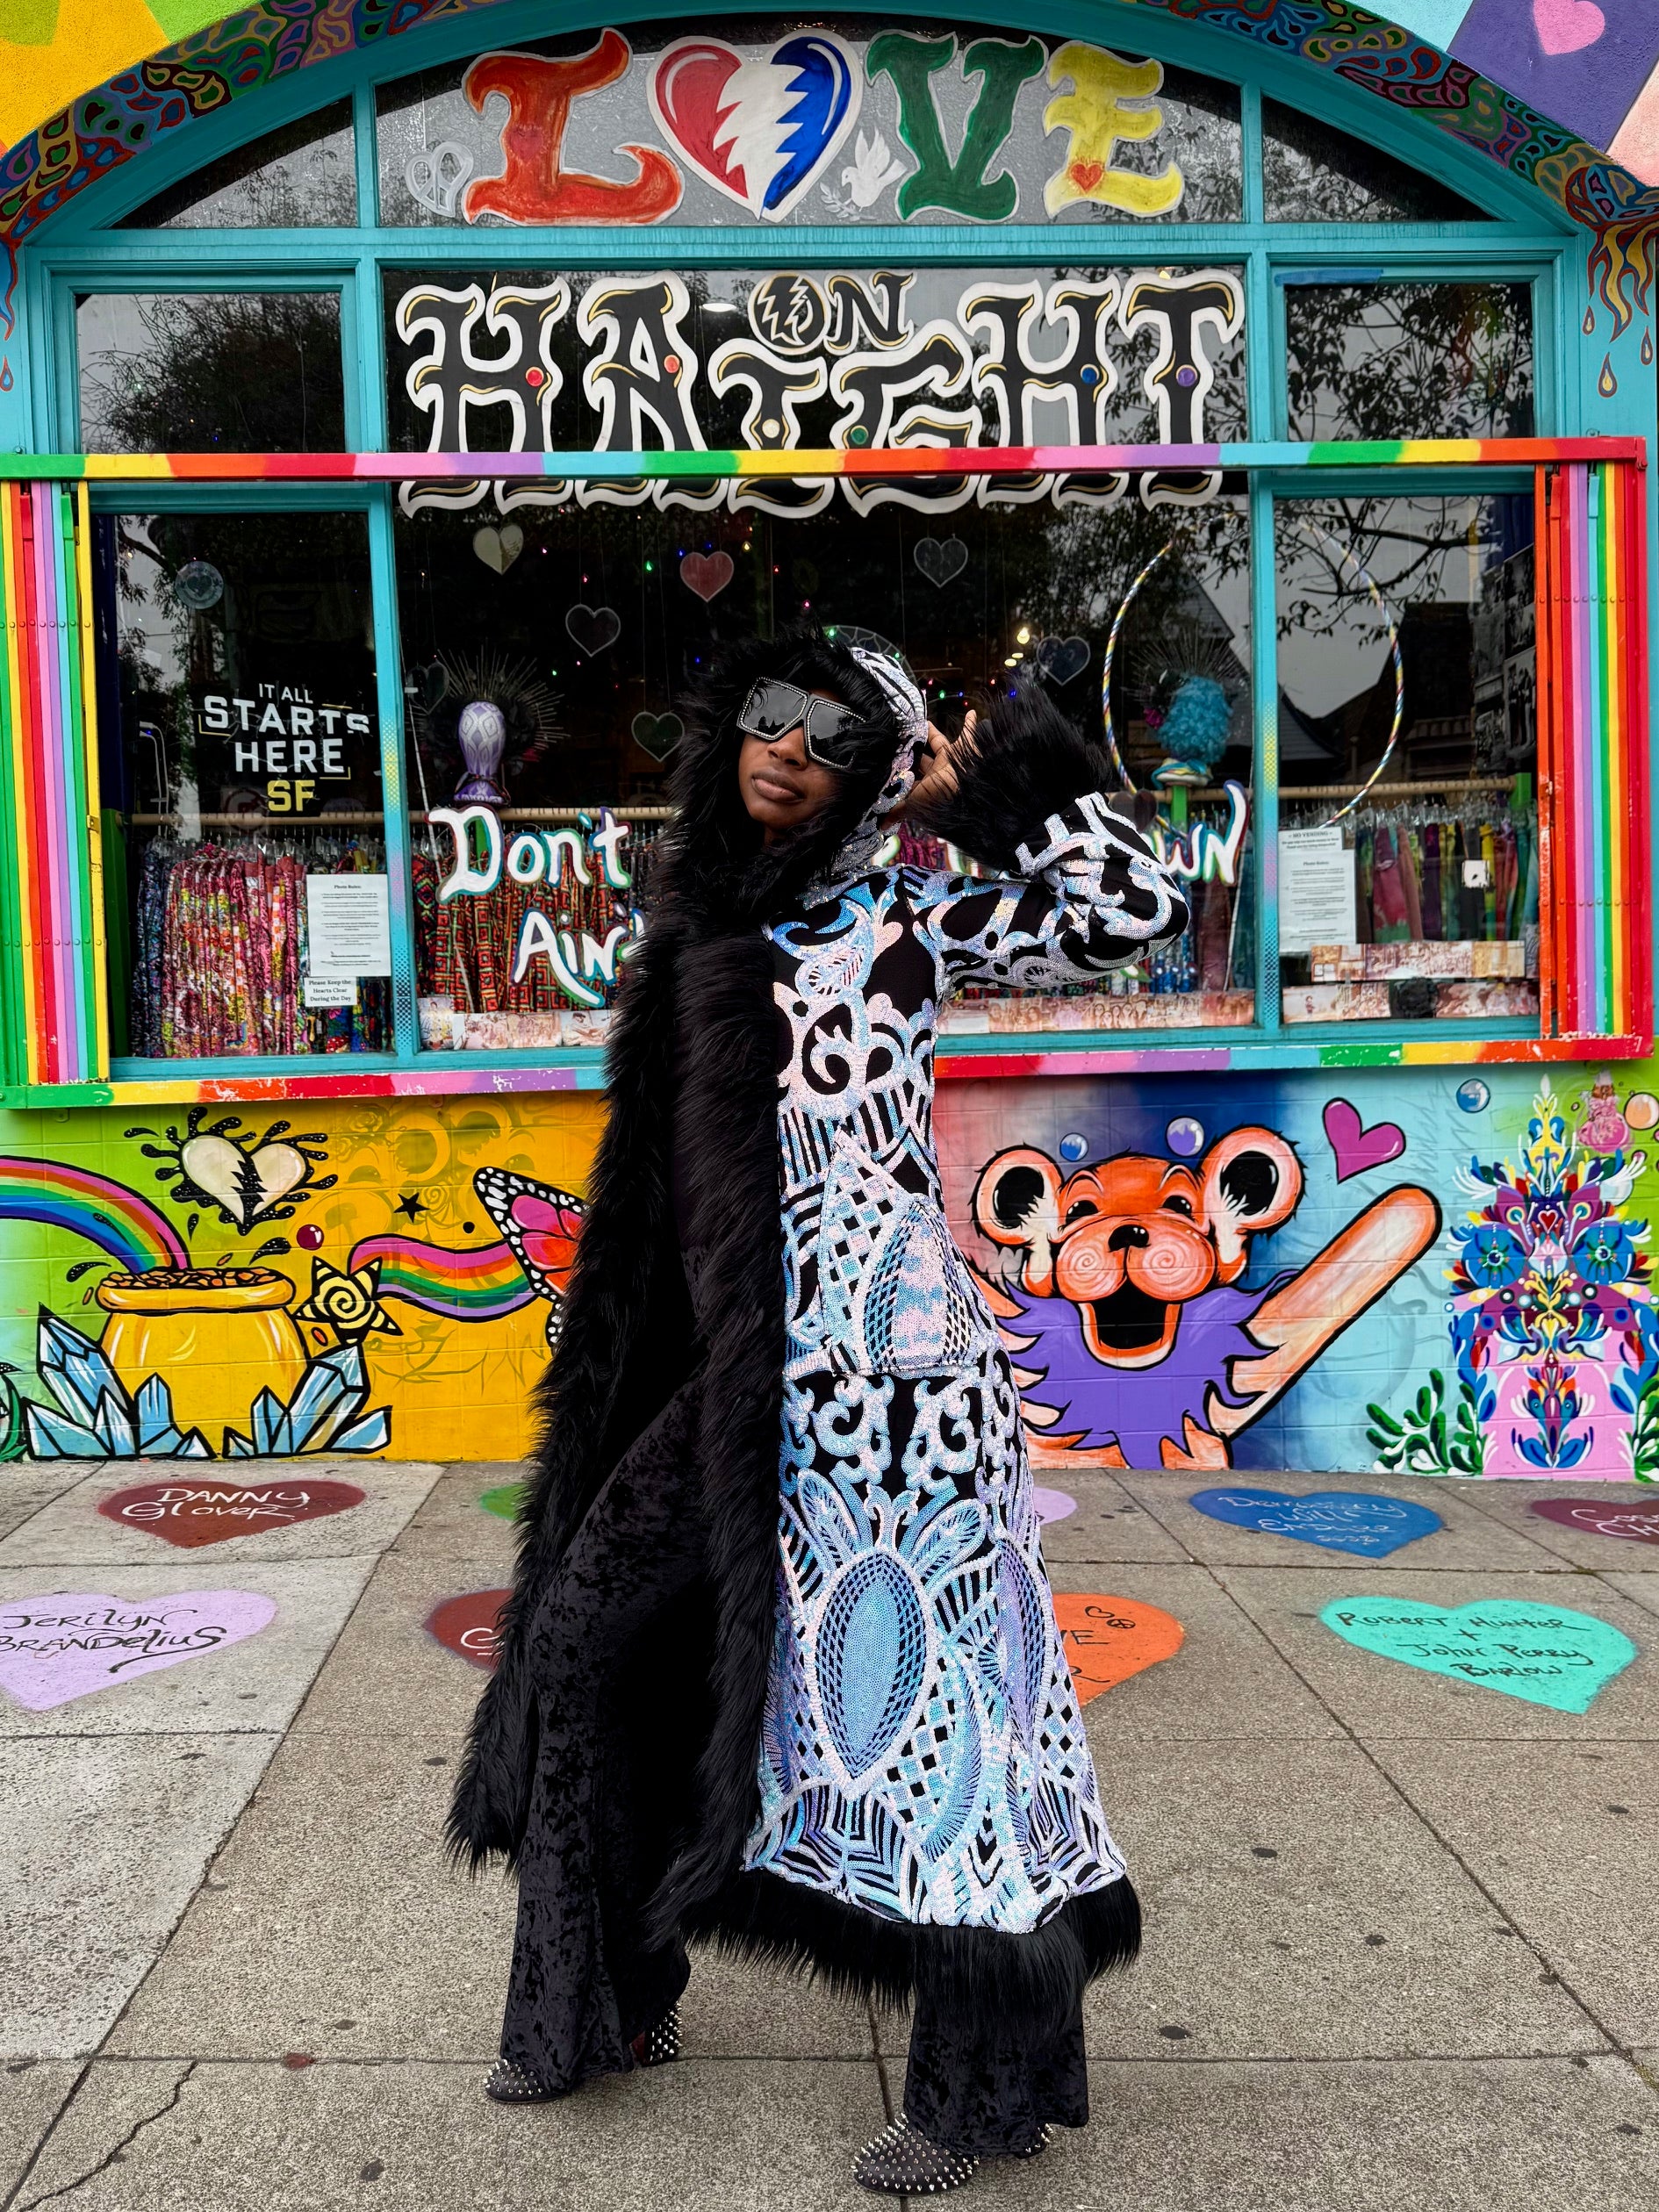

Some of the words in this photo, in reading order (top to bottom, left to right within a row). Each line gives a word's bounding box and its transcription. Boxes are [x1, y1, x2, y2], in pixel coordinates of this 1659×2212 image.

[748, 268, 917, 356] ON
[396, 269, 1246, 519] HAIGHT
[259, 683, 275, 699] IT
[281, 686, 313, 704] ALL
[204, 695, 370, 736] STARTS
[235, 738, 345, 773] HERE
[267, 779, 315, 812] SF
[424, 801, 632, 905] Don't
